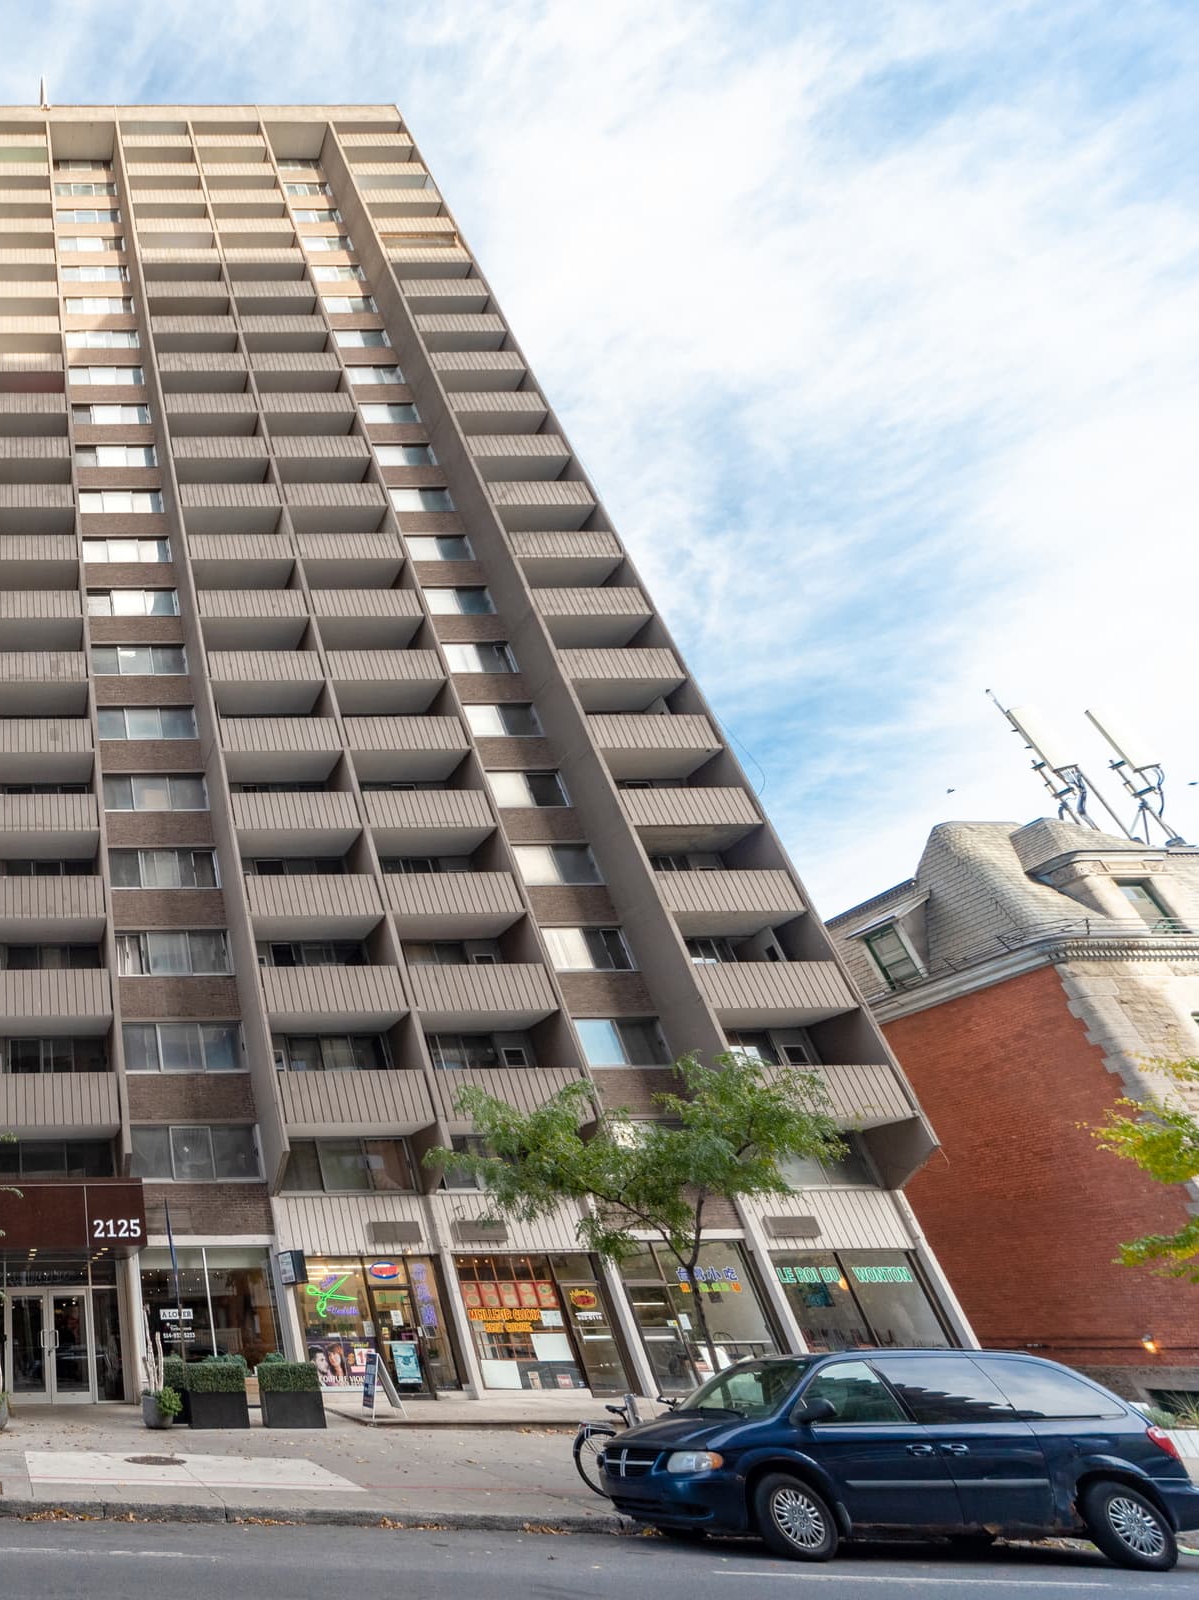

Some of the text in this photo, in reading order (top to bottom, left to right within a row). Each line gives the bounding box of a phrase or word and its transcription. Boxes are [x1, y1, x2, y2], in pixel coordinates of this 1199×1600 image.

[93, 1219, 141, 1238] 2125
[776, 1267, 913, 1283] LE ROI DU WONTON
[467, 1309, 513, 1320] MEILLEUR
